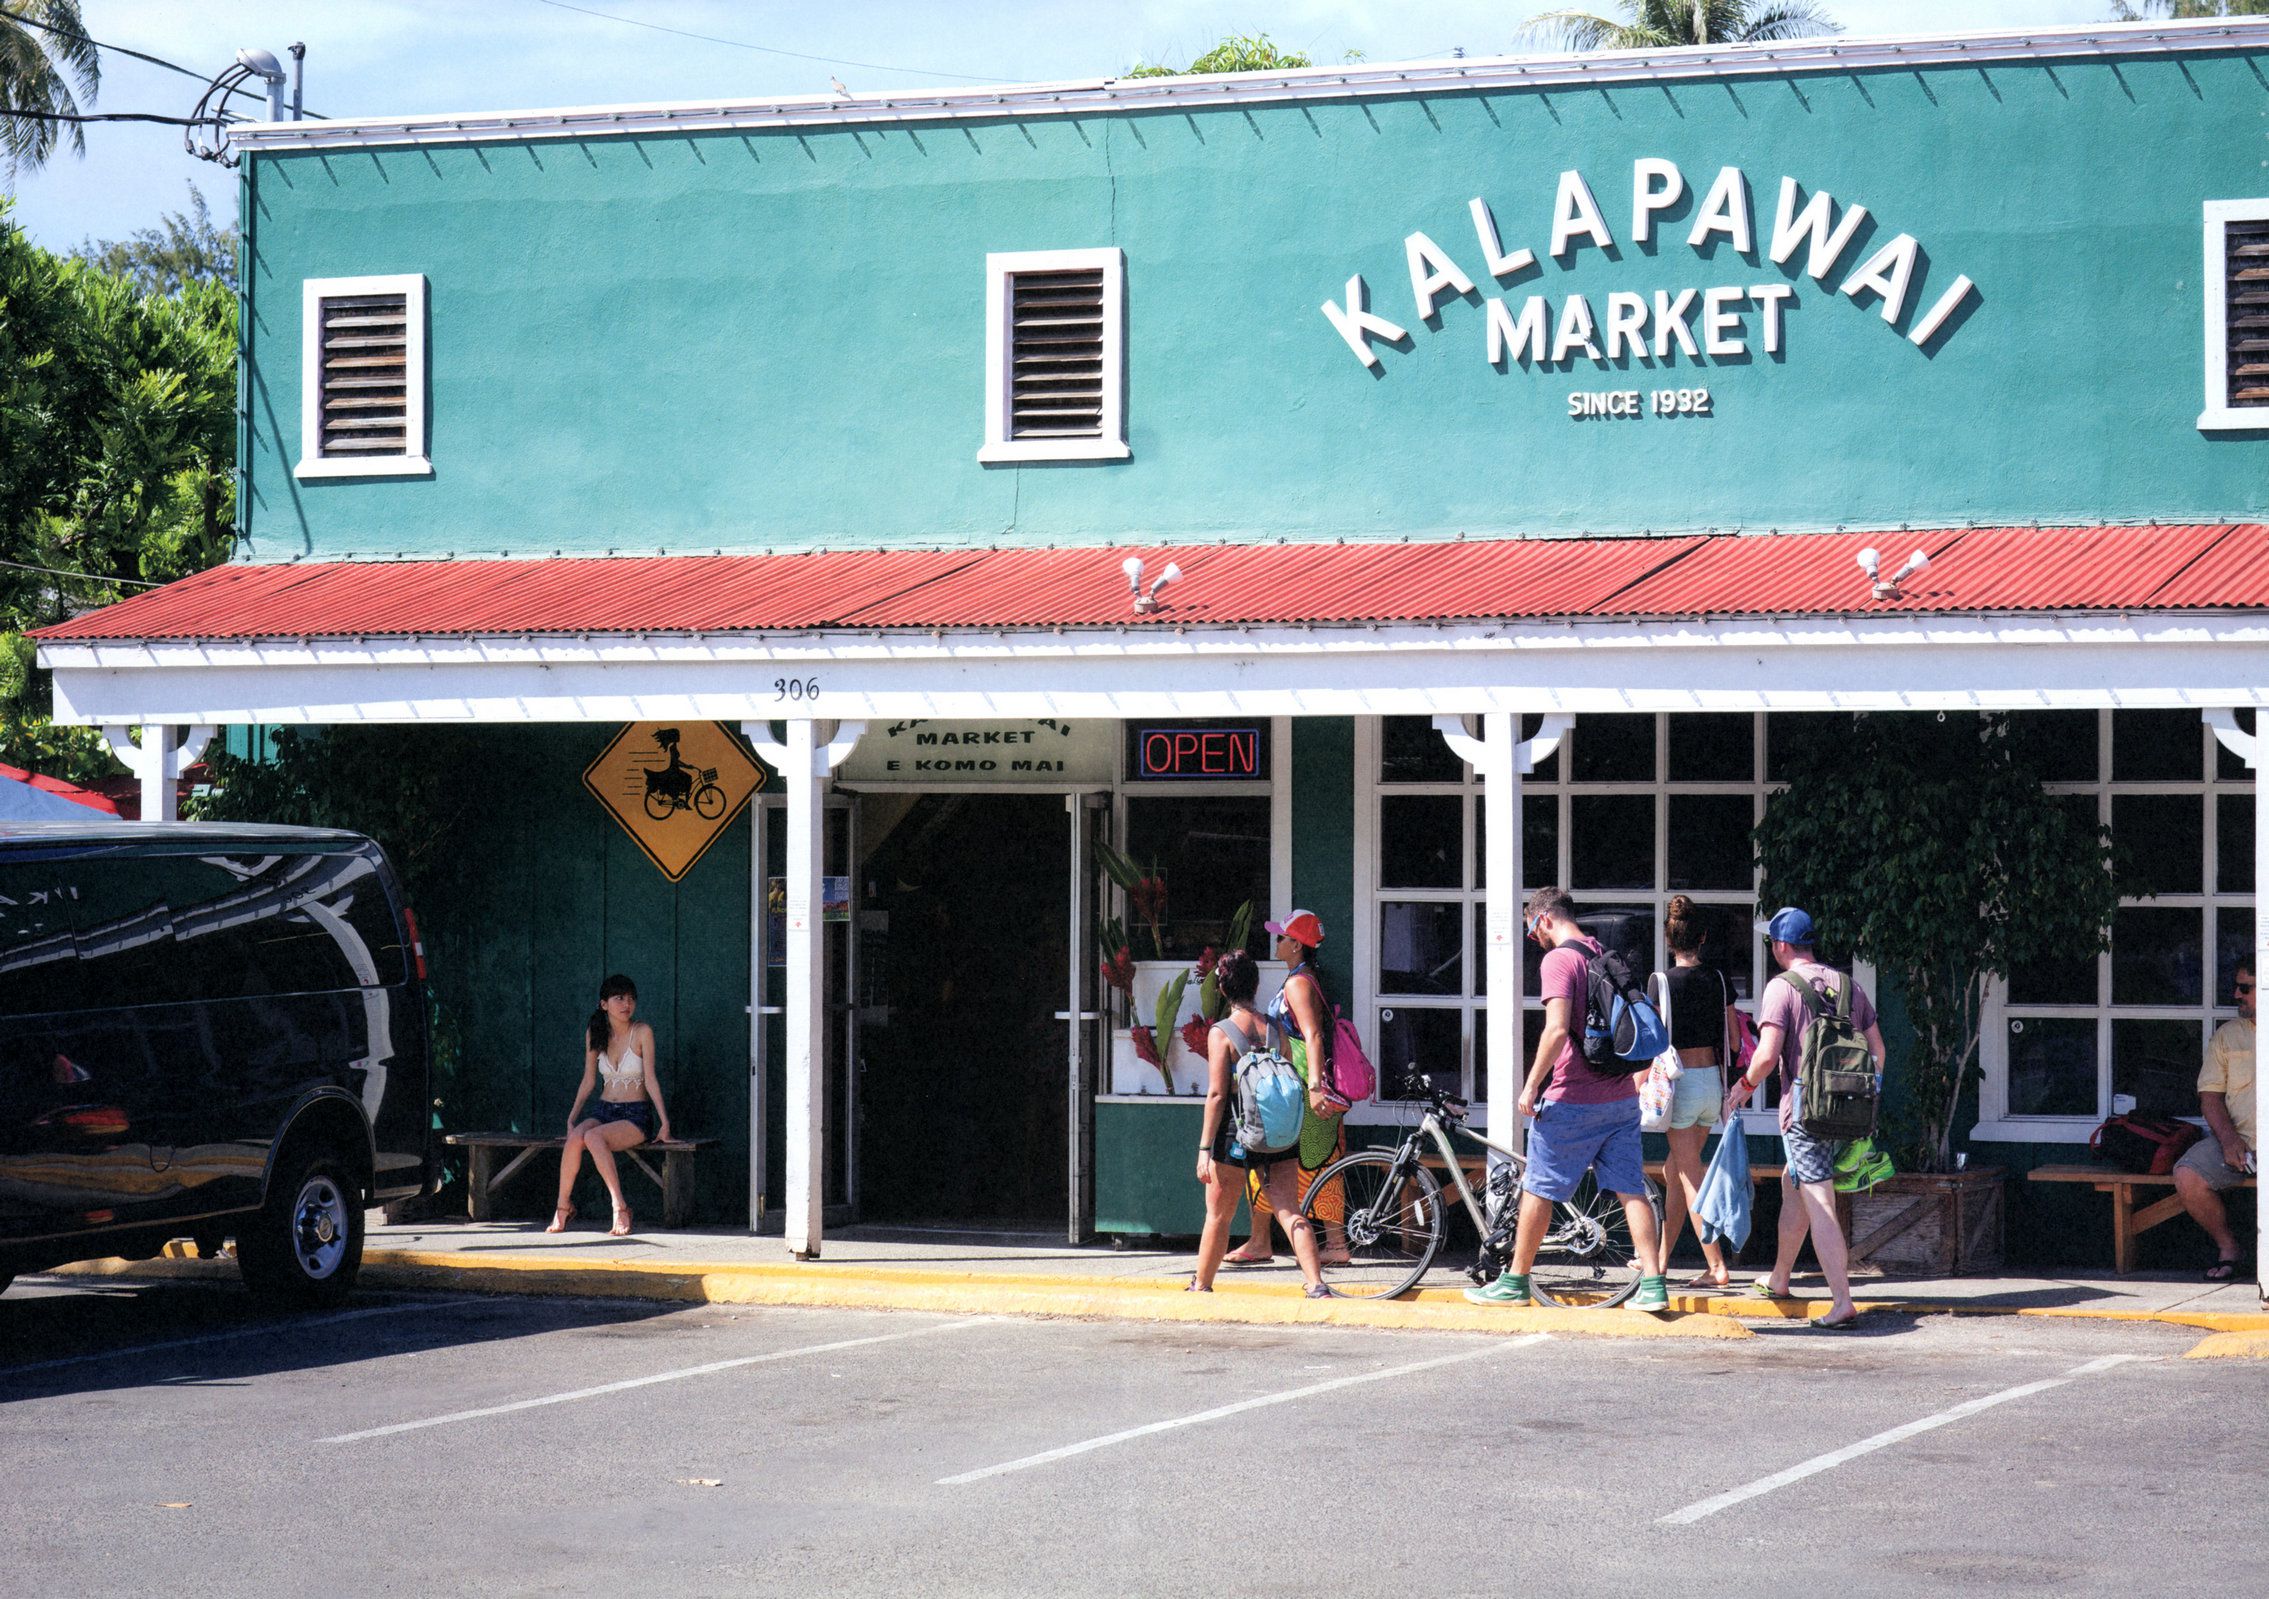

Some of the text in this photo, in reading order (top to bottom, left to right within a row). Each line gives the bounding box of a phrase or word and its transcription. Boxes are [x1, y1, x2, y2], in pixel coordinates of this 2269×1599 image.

[1320, 158, 1974, 368] KALAPAWAI
[1486, 284, 1794, 364] MARKET
[1567, 388, 1710, 416] SINCE 1932
[774, 677, 820, 702] 306
[916, 731, 1036, 745] MARKET
[887, 760, 1065, 772] E KOMO MAI
[1146, 734, 1254, 773] OPEN
